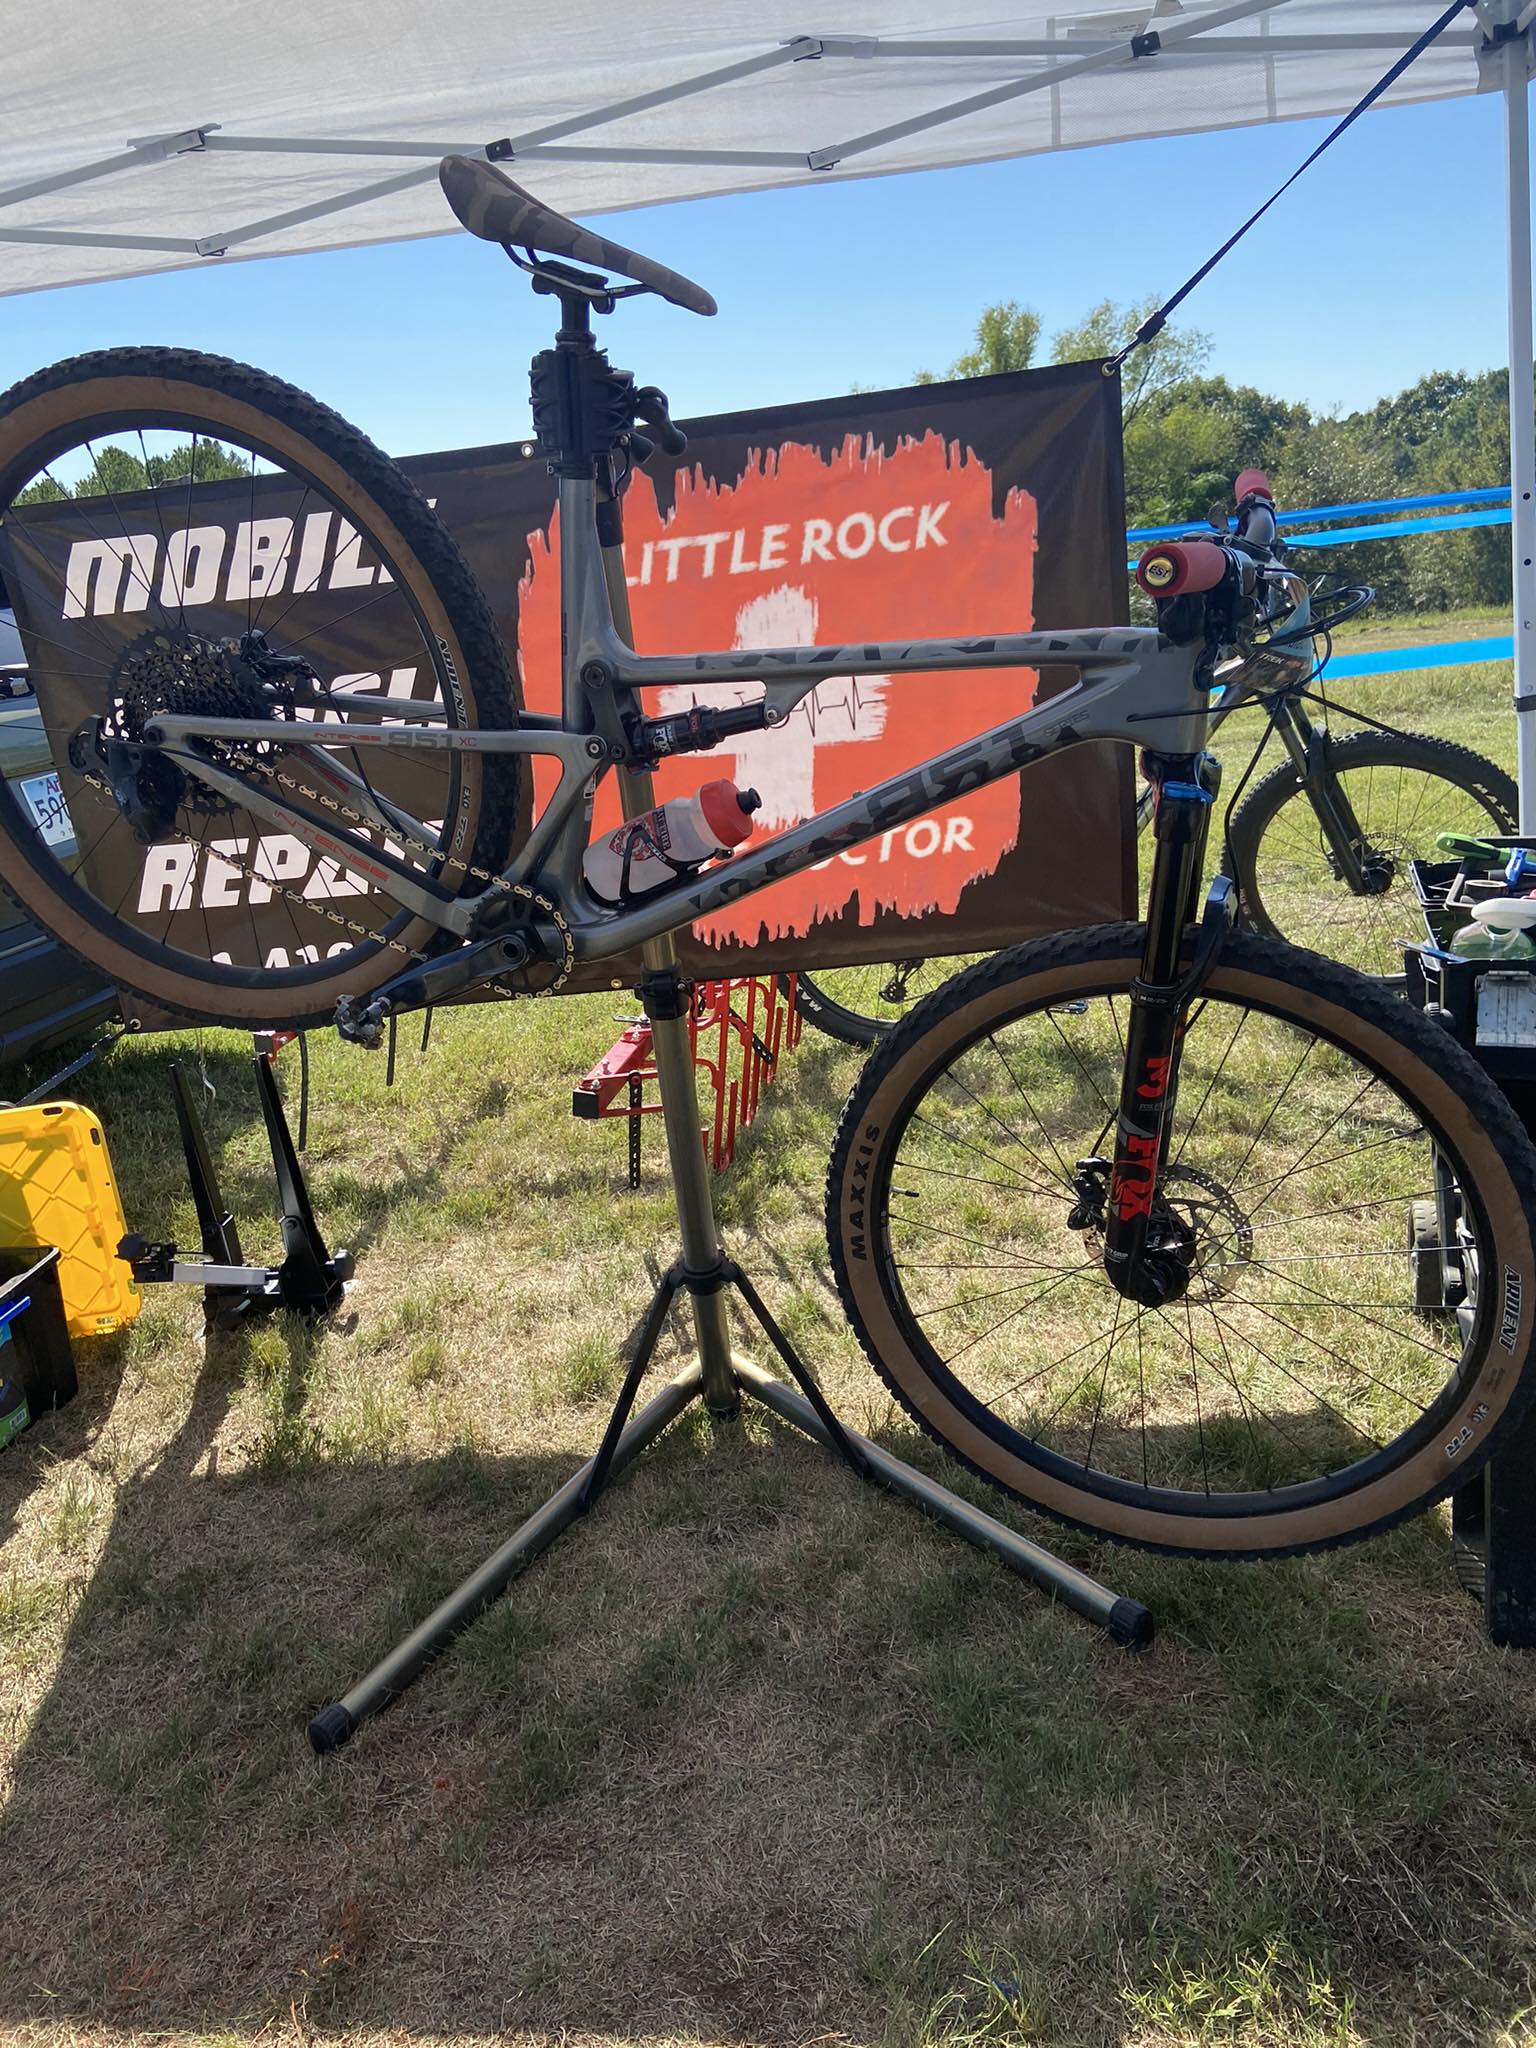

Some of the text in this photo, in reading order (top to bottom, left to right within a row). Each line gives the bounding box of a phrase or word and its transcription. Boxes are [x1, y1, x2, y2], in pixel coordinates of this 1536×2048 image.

[62, 499, 437, 620] MOBIL
[801, 501, 951, 565] ROCK
[1260, 651, 1285, 665] TREK
[459, 736, 478, 747] XC
[137, 820, 443, 914] REPA
[272, 810, 390, 882] INTENSE
[809, 816, 976, 871] TOR
[849, 1123, 880, 1261] MAXXIS
[1110, 1134, 1162, 1222] FOX
[1500, 1264, 1522, 1355] ARDENT
[1445, 1425, 1474, 1458] TR
[1471, 1402, 1489, 1423] EXO
